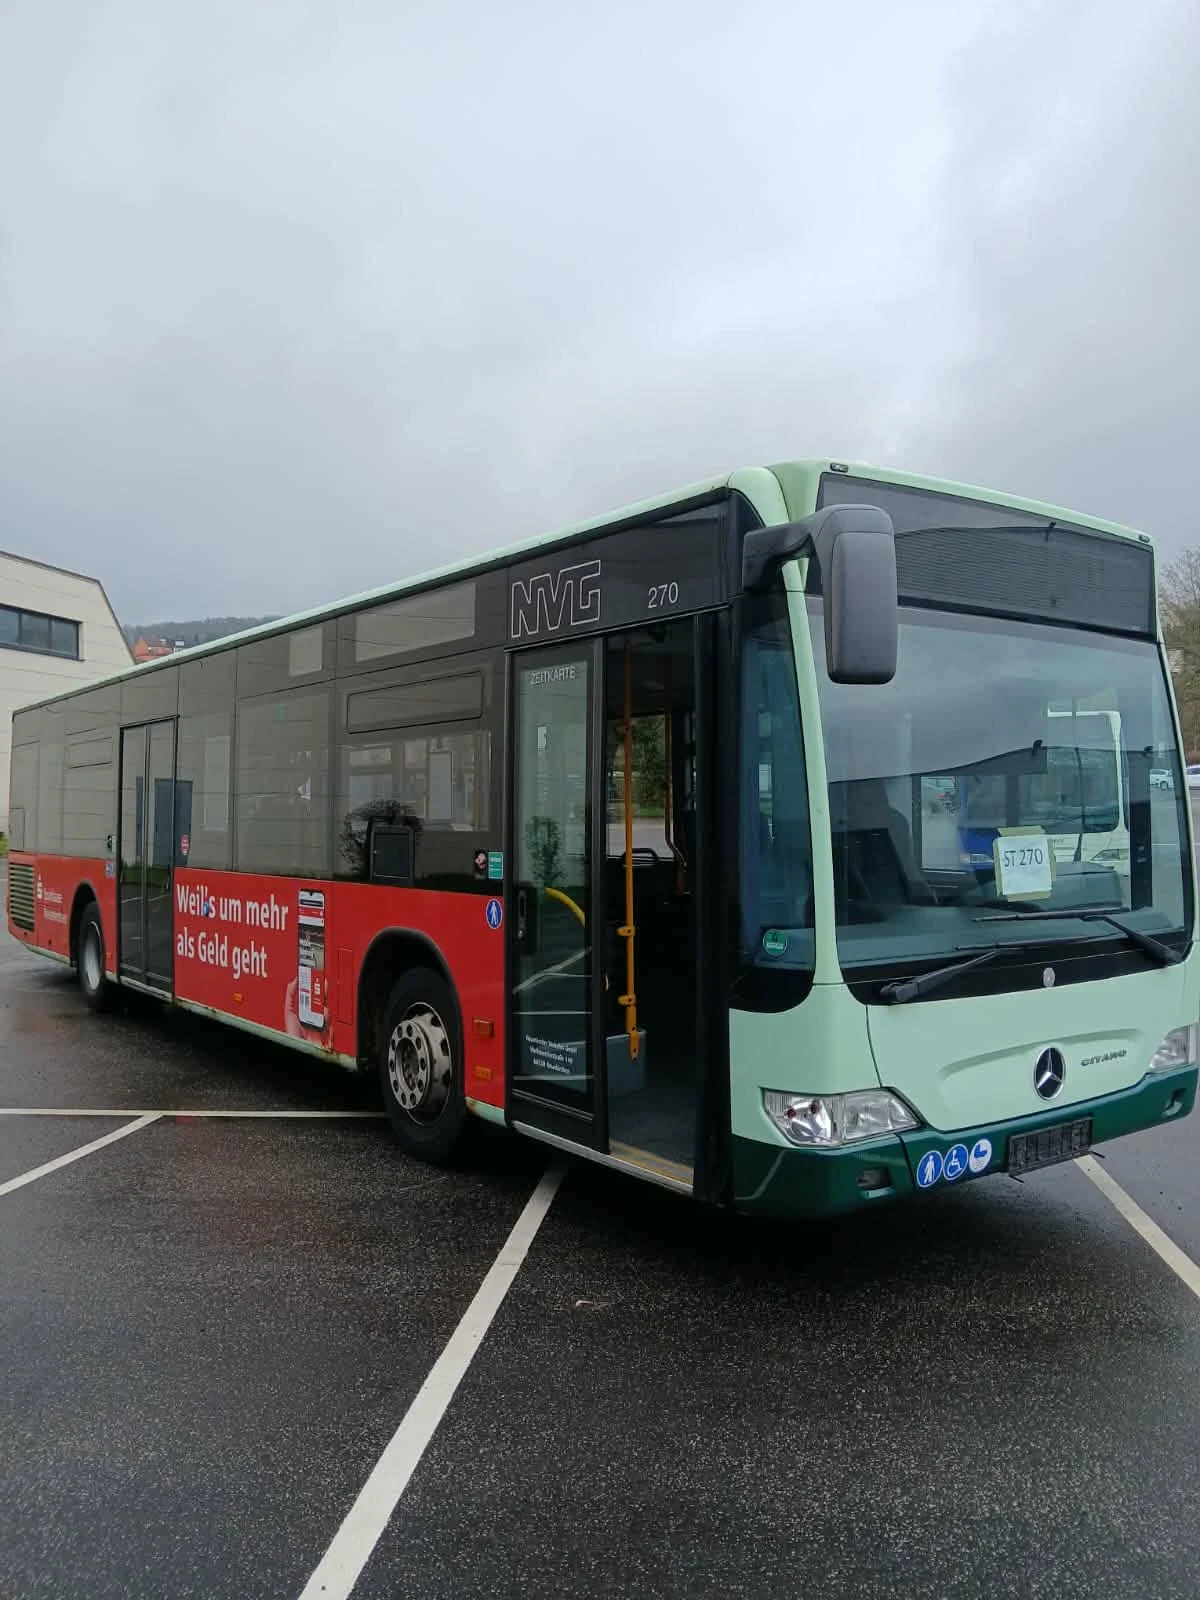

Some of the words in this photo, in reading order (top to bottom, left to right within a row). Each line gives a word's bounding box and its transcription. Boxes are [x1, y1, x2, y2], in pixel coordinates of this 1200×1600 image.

[511, 560, 601, 638] NVG
[647, 582, 679, 609] 270
[530, 665, 577, 686] ZEITKARTE
[1019, 848, 1043, 866] 270
[219, 896, 241, 923] um
[246, 894, 288, 931] mehr
[177, 927, 194, 959] als
[198, 931, 228, 968] Geld
[232, 941, 268, 979] geht
